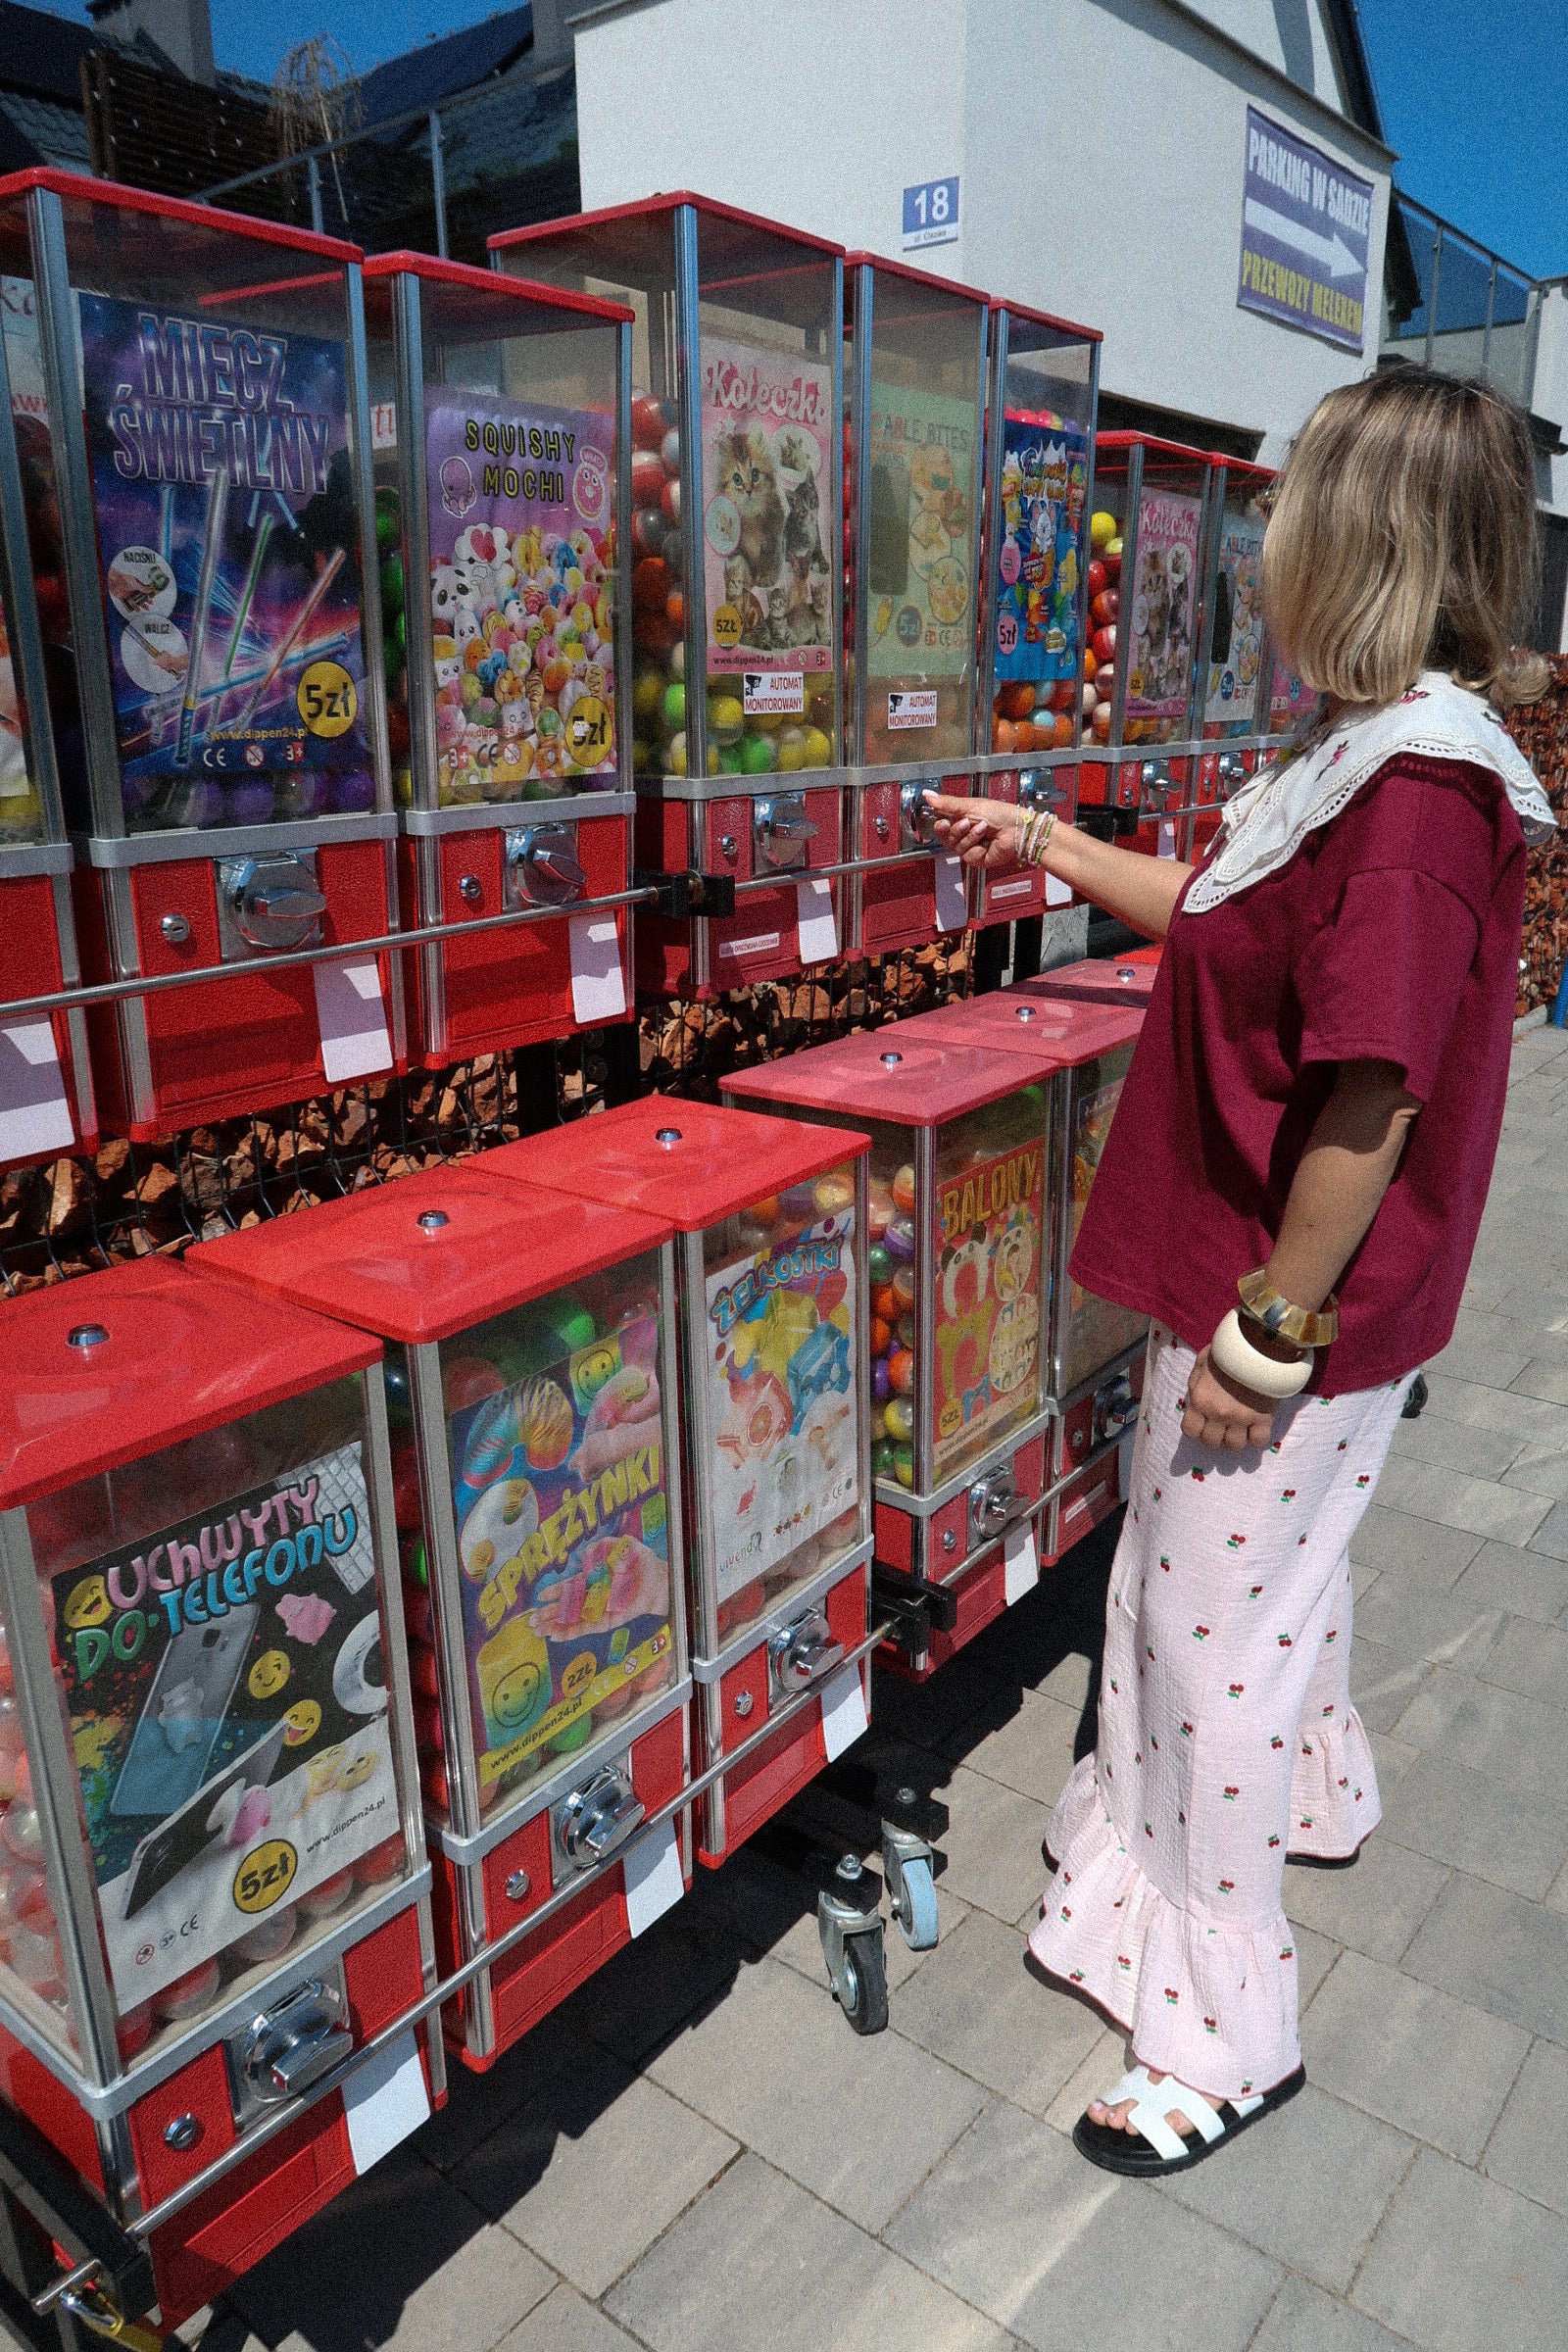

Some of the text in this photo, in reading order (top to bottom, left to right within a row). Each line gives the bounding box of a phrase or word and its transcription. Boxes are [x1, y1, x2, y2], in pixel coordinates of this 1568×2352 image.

[1249, 126, 1370, 236] PARKING W SADZIE
[914, 185, 950, 224] 18
[1241, 248, 1311, 313] PRZEWOZY
[138, 312, 294, 413] MIECZ
[112, 384, 330, 494] ŚWIETLNY
[465, 418, 576, 465] SQUISHY
[482, 466, 565, 503] MOCHI
[145, 623, 171, 634] WALCZ
[999, 624, 1017, 645] 5zł
[711, 655, 774, 665] www.dippen24.pl
[306, 681, 351, 719] 5zł
[770, 677, 803, 690] AUTOMAT
[909, 695, 937, 708] AUTOMAT
[745, 697, 803, 711] MONITOROWANY
[889, 714, 936, 727] MONITOROWANY
[571, 712, 607, 747] 5zł
[203, 748, 227, 767] CE
[476, 743, 500, 768] CE
[944, 1149, 1039, 1242] BALONY
[477, 1444, 660, 1632] SPRĘŻYNKI
[74, 1609, 146, 1683] DO
[490, 1696, 583, 1770] www.dippen24.pl
[306, 1796, 387, 1853] www.dippen24.pl
[241, 1851, 291, 1902] 5zł
[179, 1914, 200, 1937] CE
